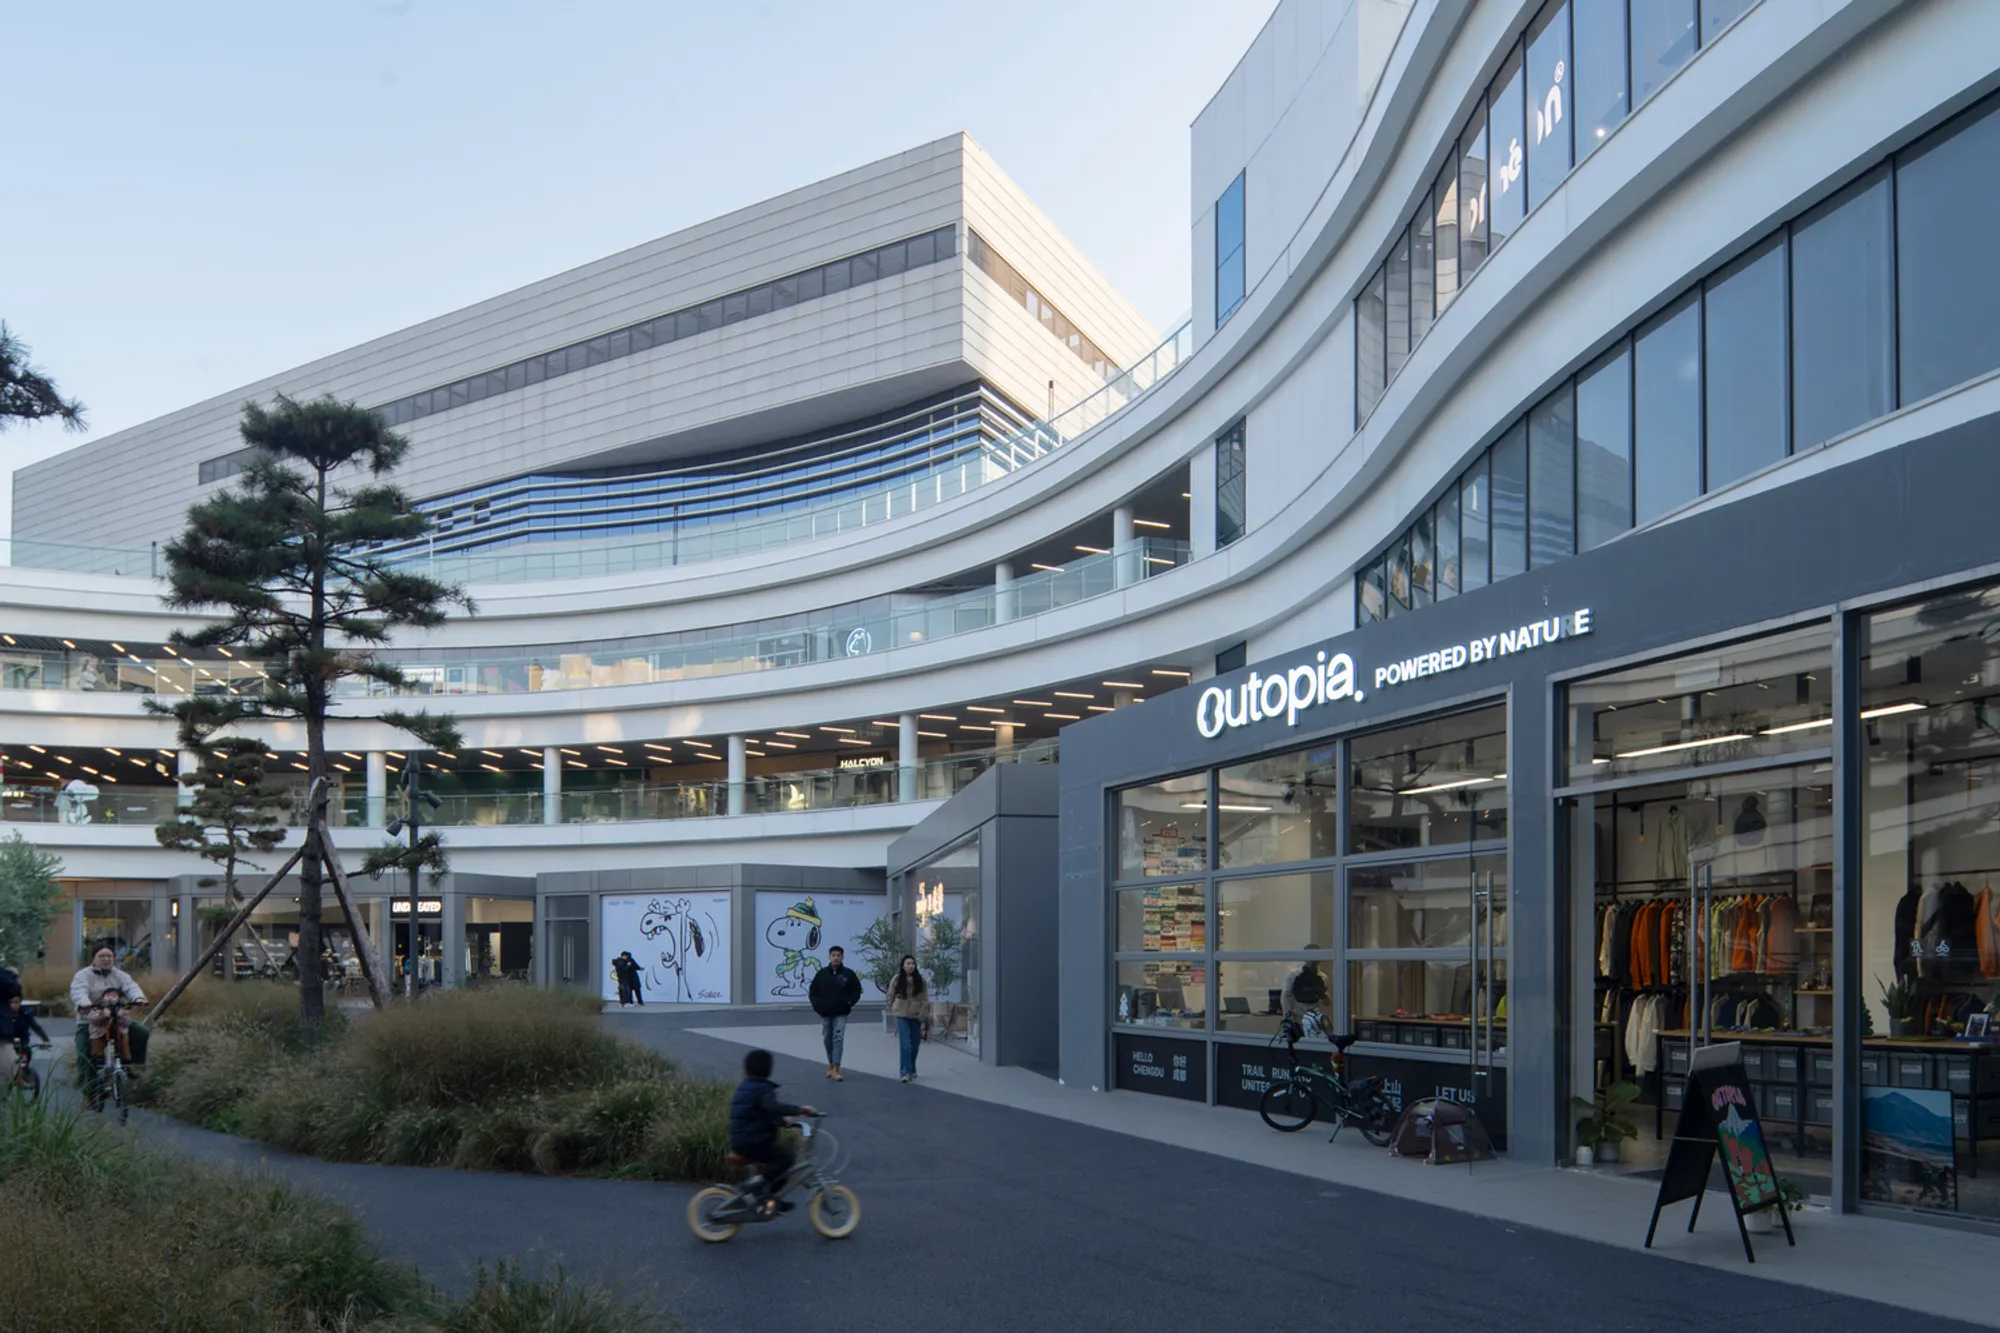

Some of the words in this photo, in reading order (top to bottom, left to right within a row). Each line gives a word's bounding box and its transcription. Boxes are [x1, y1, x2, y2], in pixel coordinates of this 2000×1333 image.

[1374, 645, 1467, 689] POWERED
[1470, 635, 1498, 664] BY
[1500, 608, 1591, 656] NATURE
[840, 756, 884, 769] HALCYON
[1132, 1050, 1154, 1063] HELLO
[1132, 1063, 1165, 1078] CHENGDU
[1240, 1063, 1266, 1078] TRAIL
[1435, 1085, 1457, 1101] LET
[1459, 1088, 1477, 1104] US
